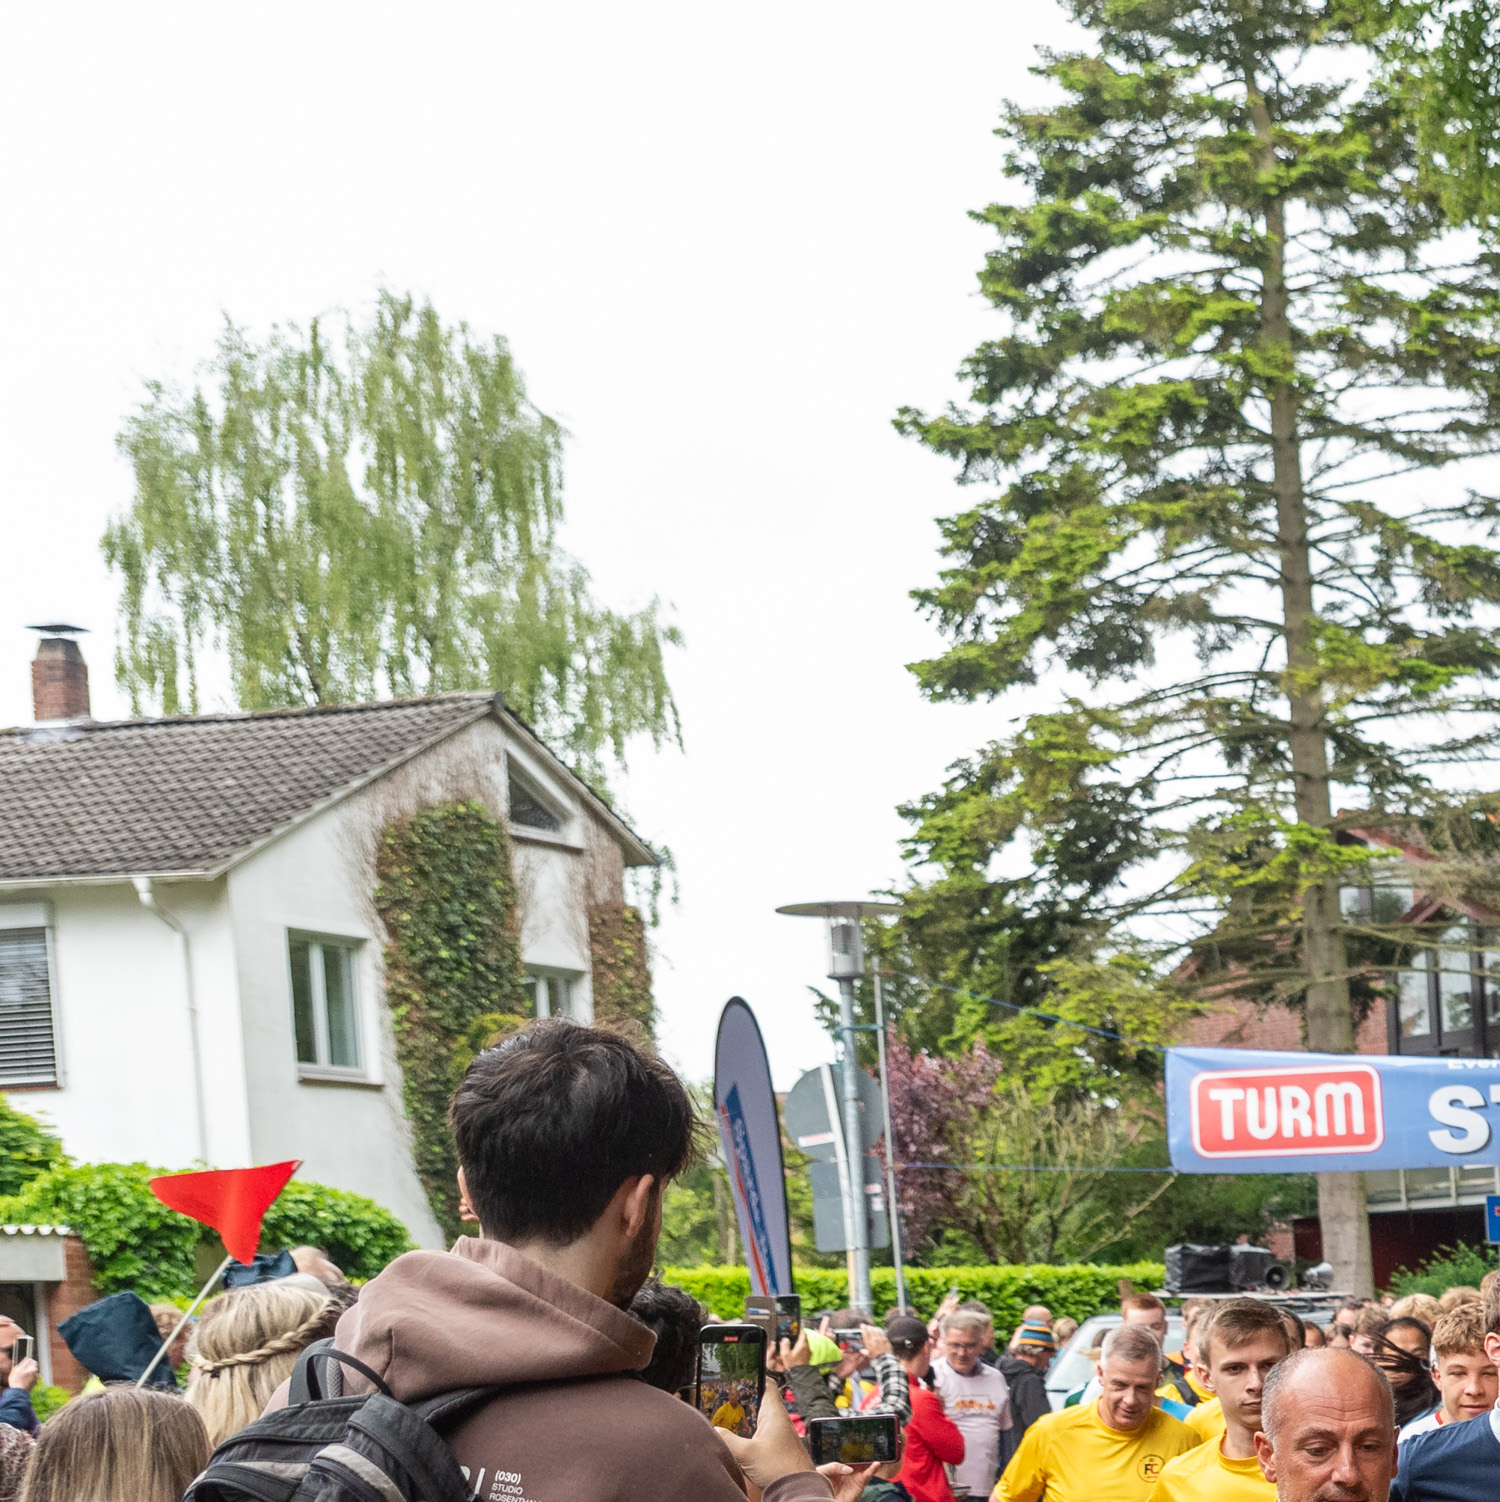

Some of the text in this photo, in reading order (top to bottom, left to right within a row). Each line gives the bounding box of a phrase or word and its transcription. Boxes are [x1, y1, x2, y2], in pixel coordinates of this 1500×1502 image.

[1209, 1081, 1365, 1140] TURM
[495, 1470, 522, 1485] (030)
[491, 1482, 523, 1495] STUDIO
